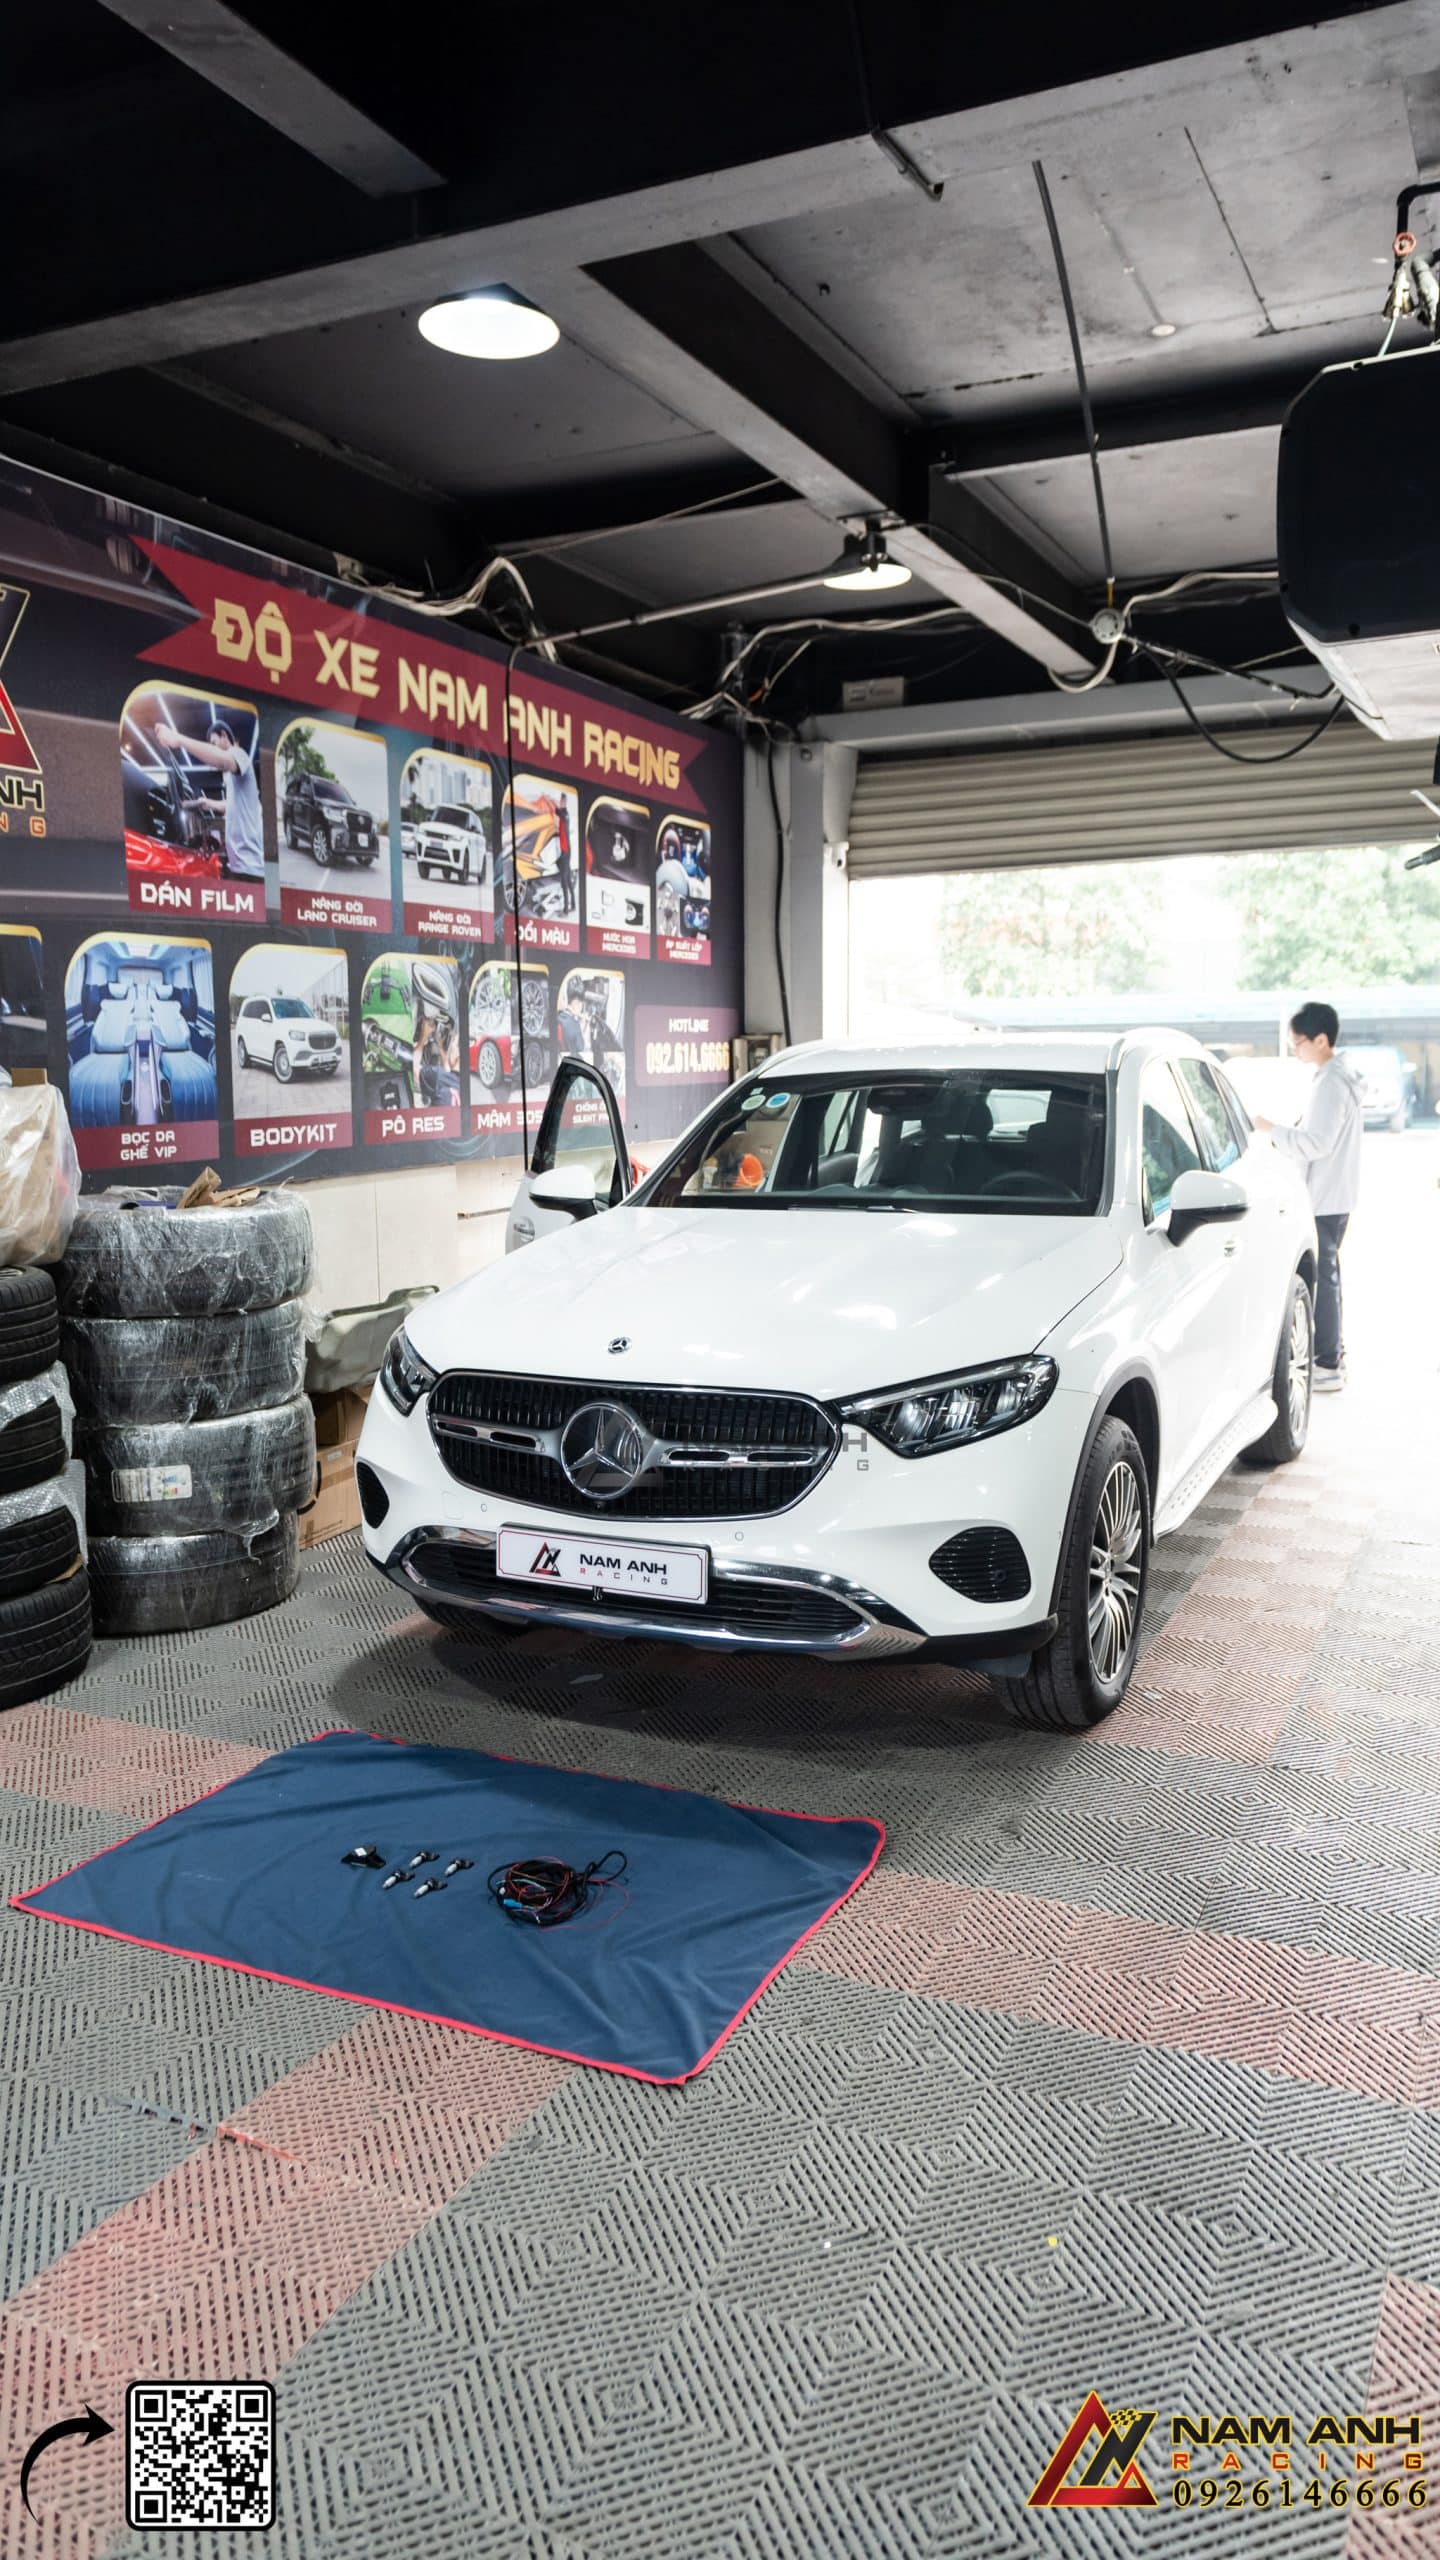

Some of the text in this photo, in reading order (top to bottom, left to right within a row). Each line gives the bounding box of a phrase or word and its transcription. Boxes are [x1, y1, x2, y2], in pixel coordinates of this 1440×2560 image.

[210, 598, 681, 790] ĐỘ XE NAM ANH RACING
[0, 775, 45, 812] NH
[140, 880, 254, 913] DÁN FILM
[297, 908, 377, 927] LAND CRUISER
[418, 921, 482, 937] RANGE ROVER
[541, 926, 570, 946] MÀU
[668, 1017, 709, 1033] HOTLINE
[382, 1114, 445, 1138] PÔ RES
[477, 1109, 511, 1129] MÂM
[121, 1130, 176, 1146] BỌC DA
[250, 1124, 337, 1147] BODYKIT
[120, 1143, 177, 1161] GHẾ VIP
[579, 1553, 667, 1575] NAM ANH
[580, 1567, 668, 1585] RACING
